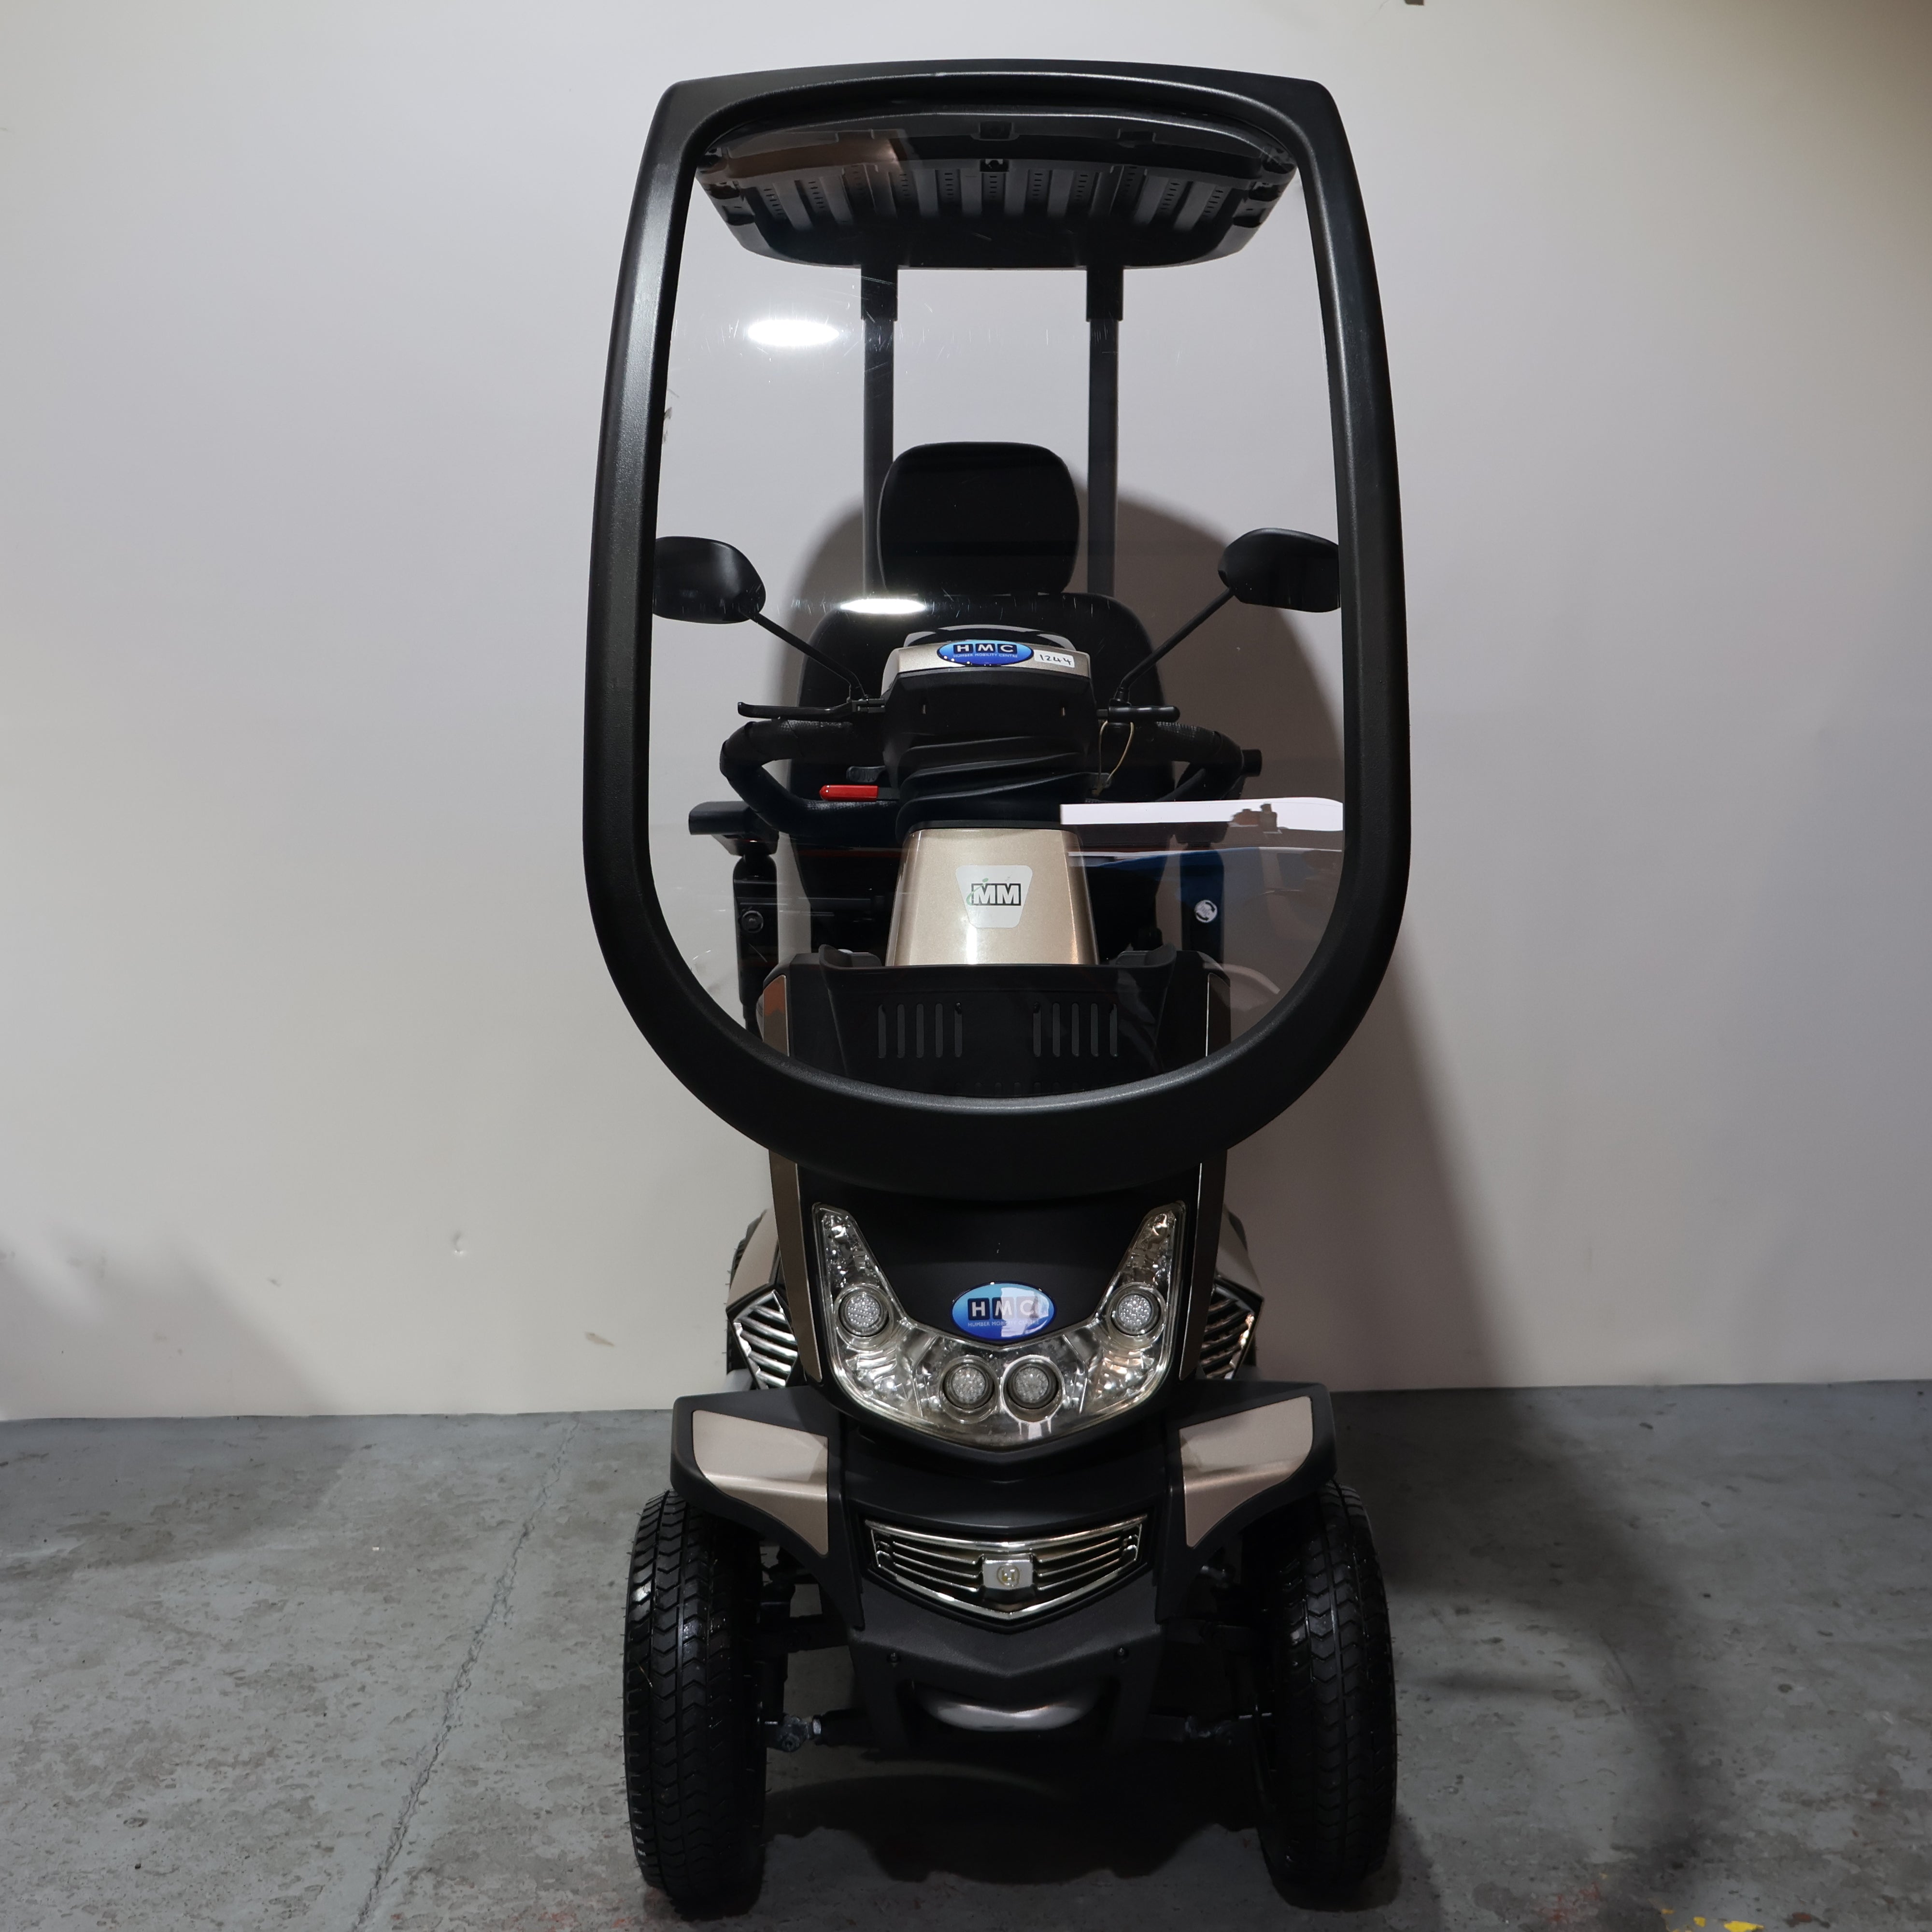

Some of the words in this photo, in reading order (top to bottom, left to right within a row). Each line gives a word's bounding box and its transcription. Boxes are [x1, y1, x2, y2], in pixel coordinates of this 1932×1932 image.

[957, 644, 1014, 652] HMC
[1039, 654, 1072, 665] 1244
[972, 1300, 1035, 1317] HMC
